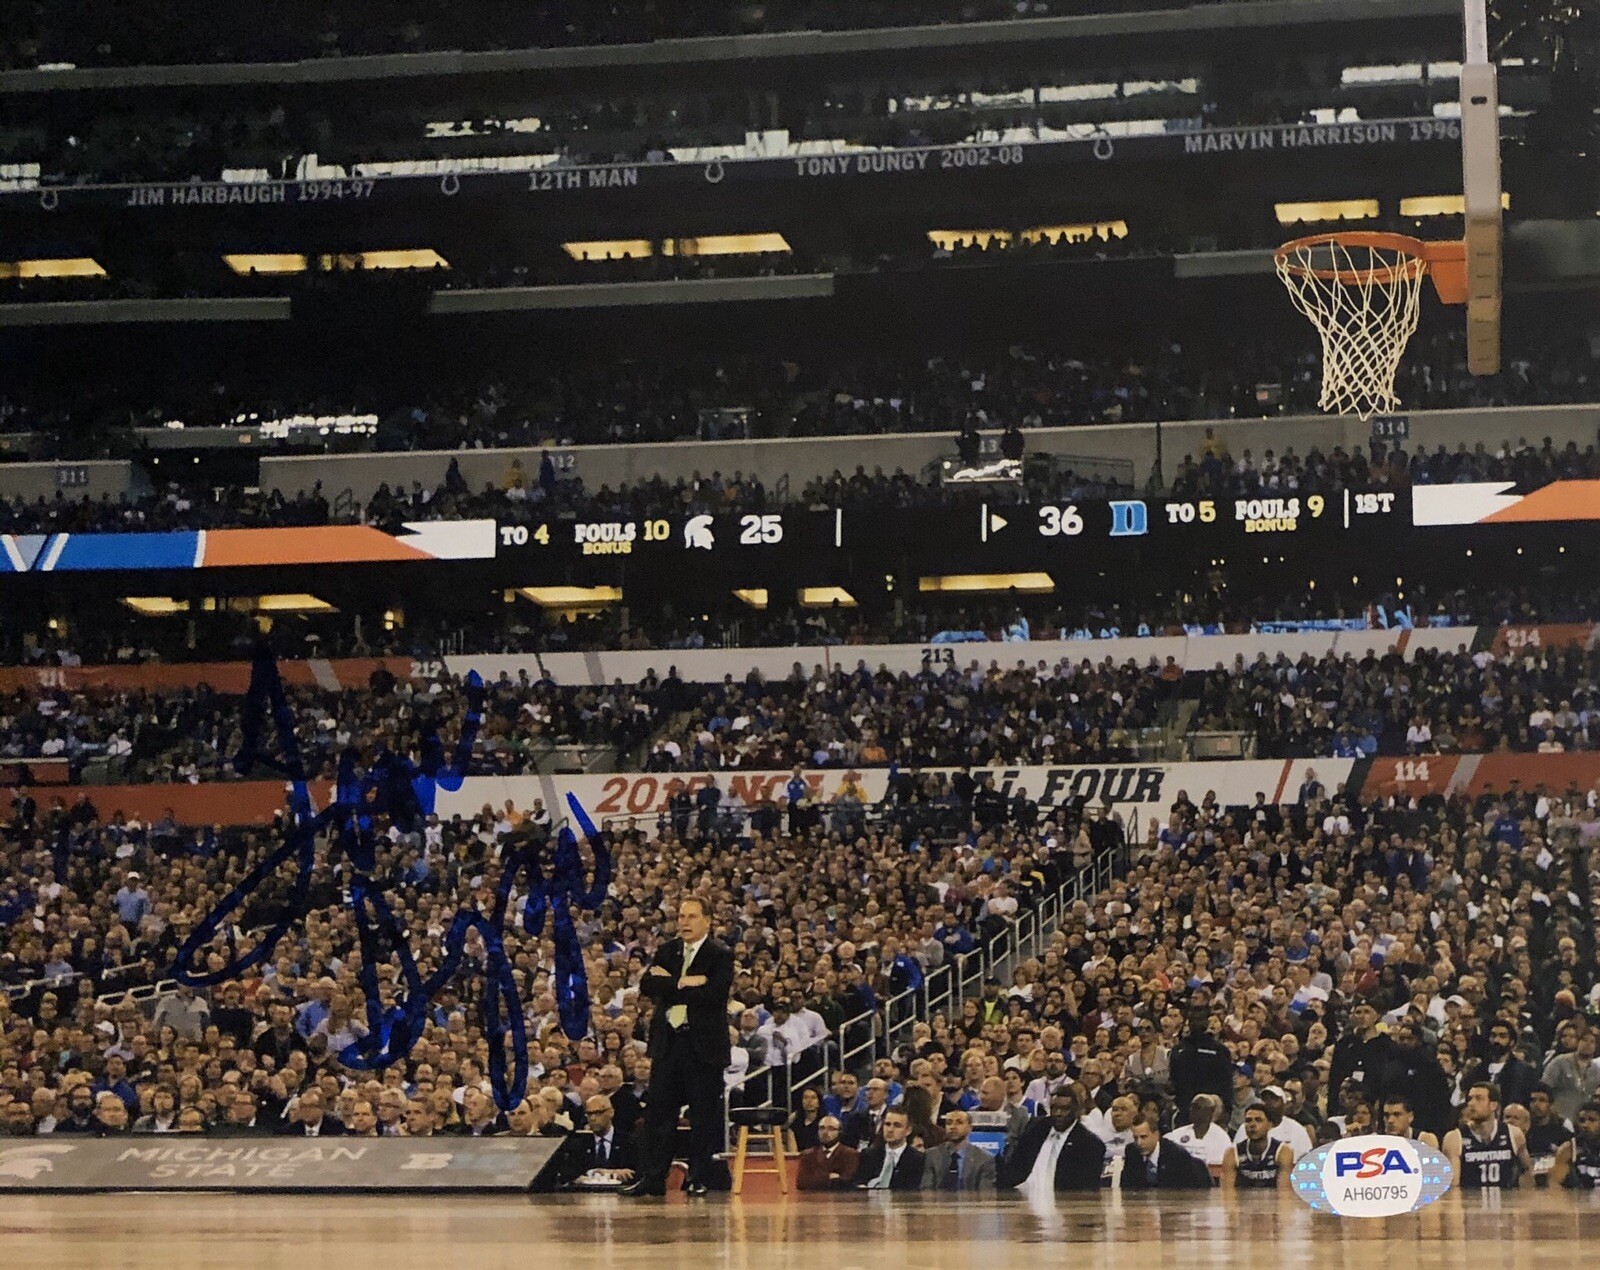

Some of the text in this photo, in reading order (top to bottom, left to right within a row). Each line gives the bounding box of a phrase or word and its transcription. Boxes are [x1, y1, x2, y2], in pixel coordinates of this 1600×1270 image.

[1184, 131, 1274, 153] MARVIN
[1281, 124, 1396, 148] HARRISON
[795, 145, 1024, 176] TONY DUNGY 2002-08
[528, 168, 638, 191] 12TH MAN
[127, 180, 375, 206] JIM HARBAUGH 1994-97
[1166, 501, 1216, 523] TO 5
[1235, 495, 1325, 521] FOULS 9
[1355, 492, 1395, 514] 1ST
[575, 519, 670, 543] FOULS 10
[739, 514, 784, 545] 25
[1038, 505, 1084, 536] 36
[1245, 518, 1297, 533] BONUS
[500, 523, 550, 545] TO 4
[582, 541, 632, 555] BONUS
[1506, 629, 1540, 647] 214
[921, 648, 955, 663] 213
[411, 661, 442, 678] 212
[1395, 761, 1429, 781] 114
[1038, 767, 1165, 806] FOUR
[116, 1147, 368, 1162] MICHIGAN
[1335, 1148, 1412, 1179] PSA
[150, 1163, 300, 1178] STATE
[1479, 1163, 1500, 1183] 10
[1343, 1185, 1408, 1201] AH60795
